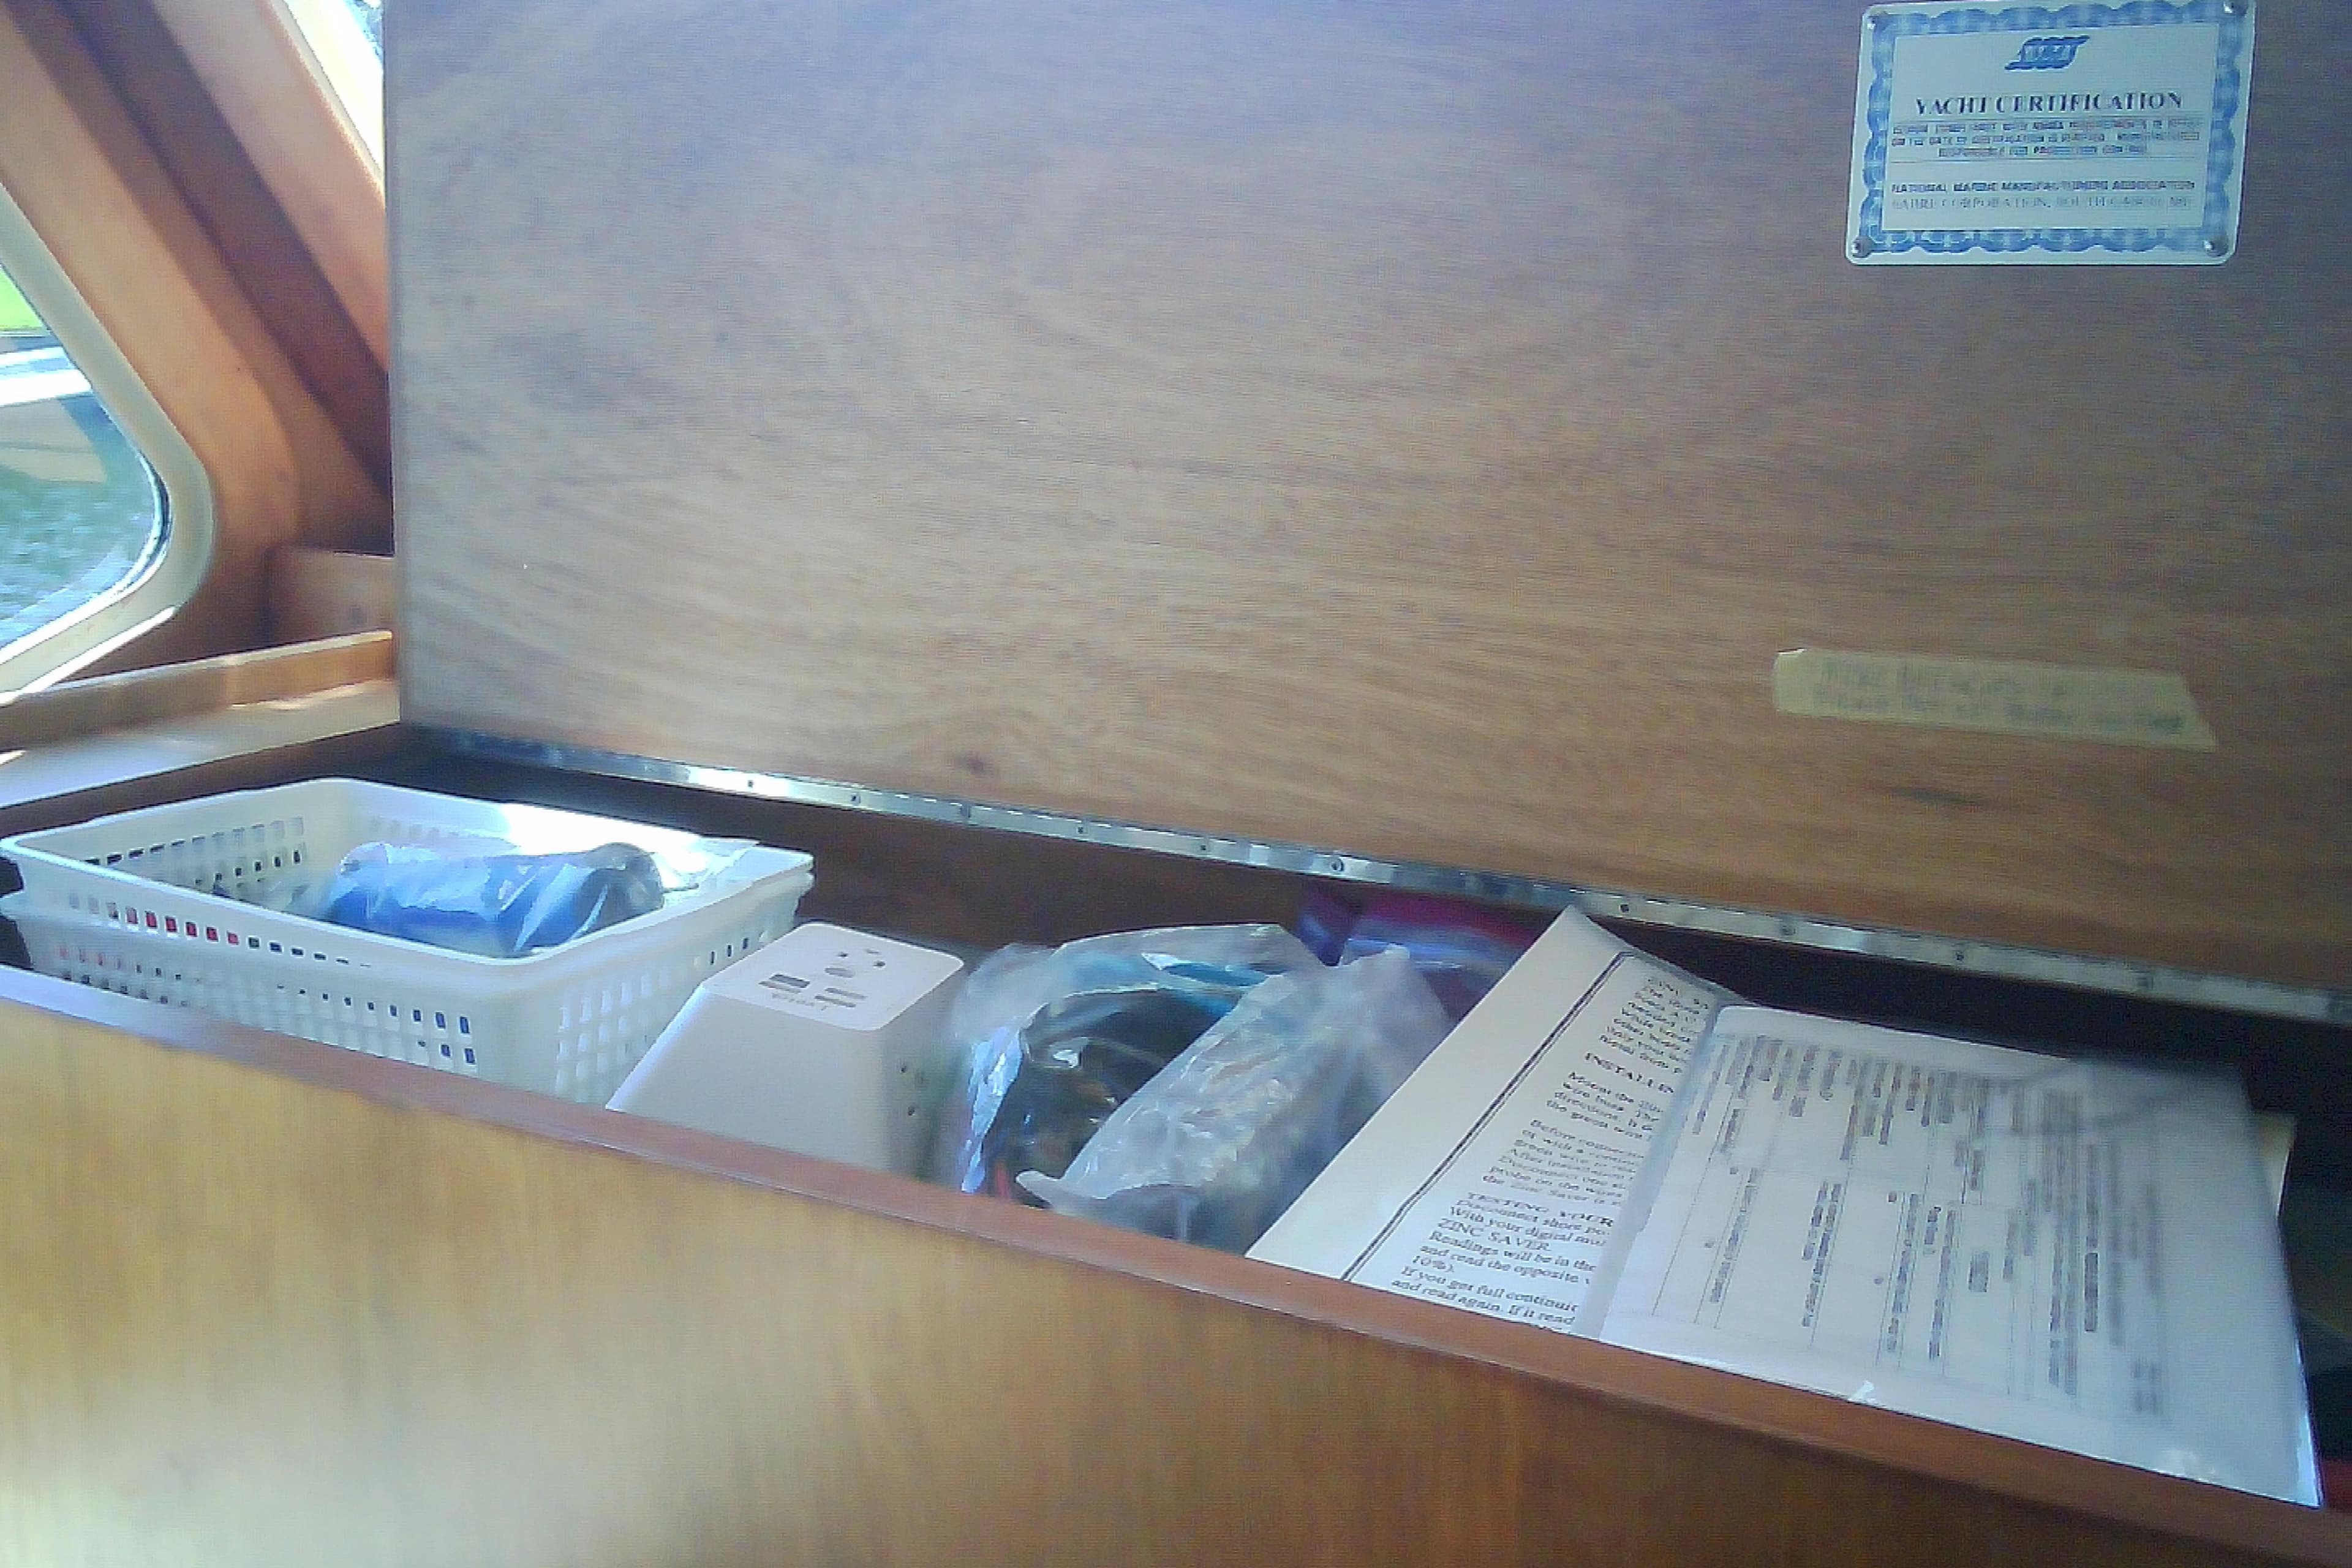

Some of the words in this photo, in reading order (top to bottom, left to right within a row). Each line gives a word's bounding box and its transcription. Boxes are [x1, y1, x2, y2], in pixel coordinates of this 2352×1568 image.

[1916, 96, 1991, 115] YACHT
[1996, 92, 2182, 113] CERTIFICATION
[1428, 1231, 1499, 1256] Readings
[1504, 1250, 1533, 1262] will
[1555, 1256, 1570, 1267] in
[1419, 1245, 1450, 1257] and
[1450, 1253, 1486, 1267] read
[1487, 1259, 1512, 1272] the
[1513, 1264, 1580, 1283] opposite
[1392, 1280, 1422, 1291] and
[1422, 1287, 1458, 1302] read
[1415, 1271, 1447, 1286] you
[1476, 1284, 1506, 1299] full
